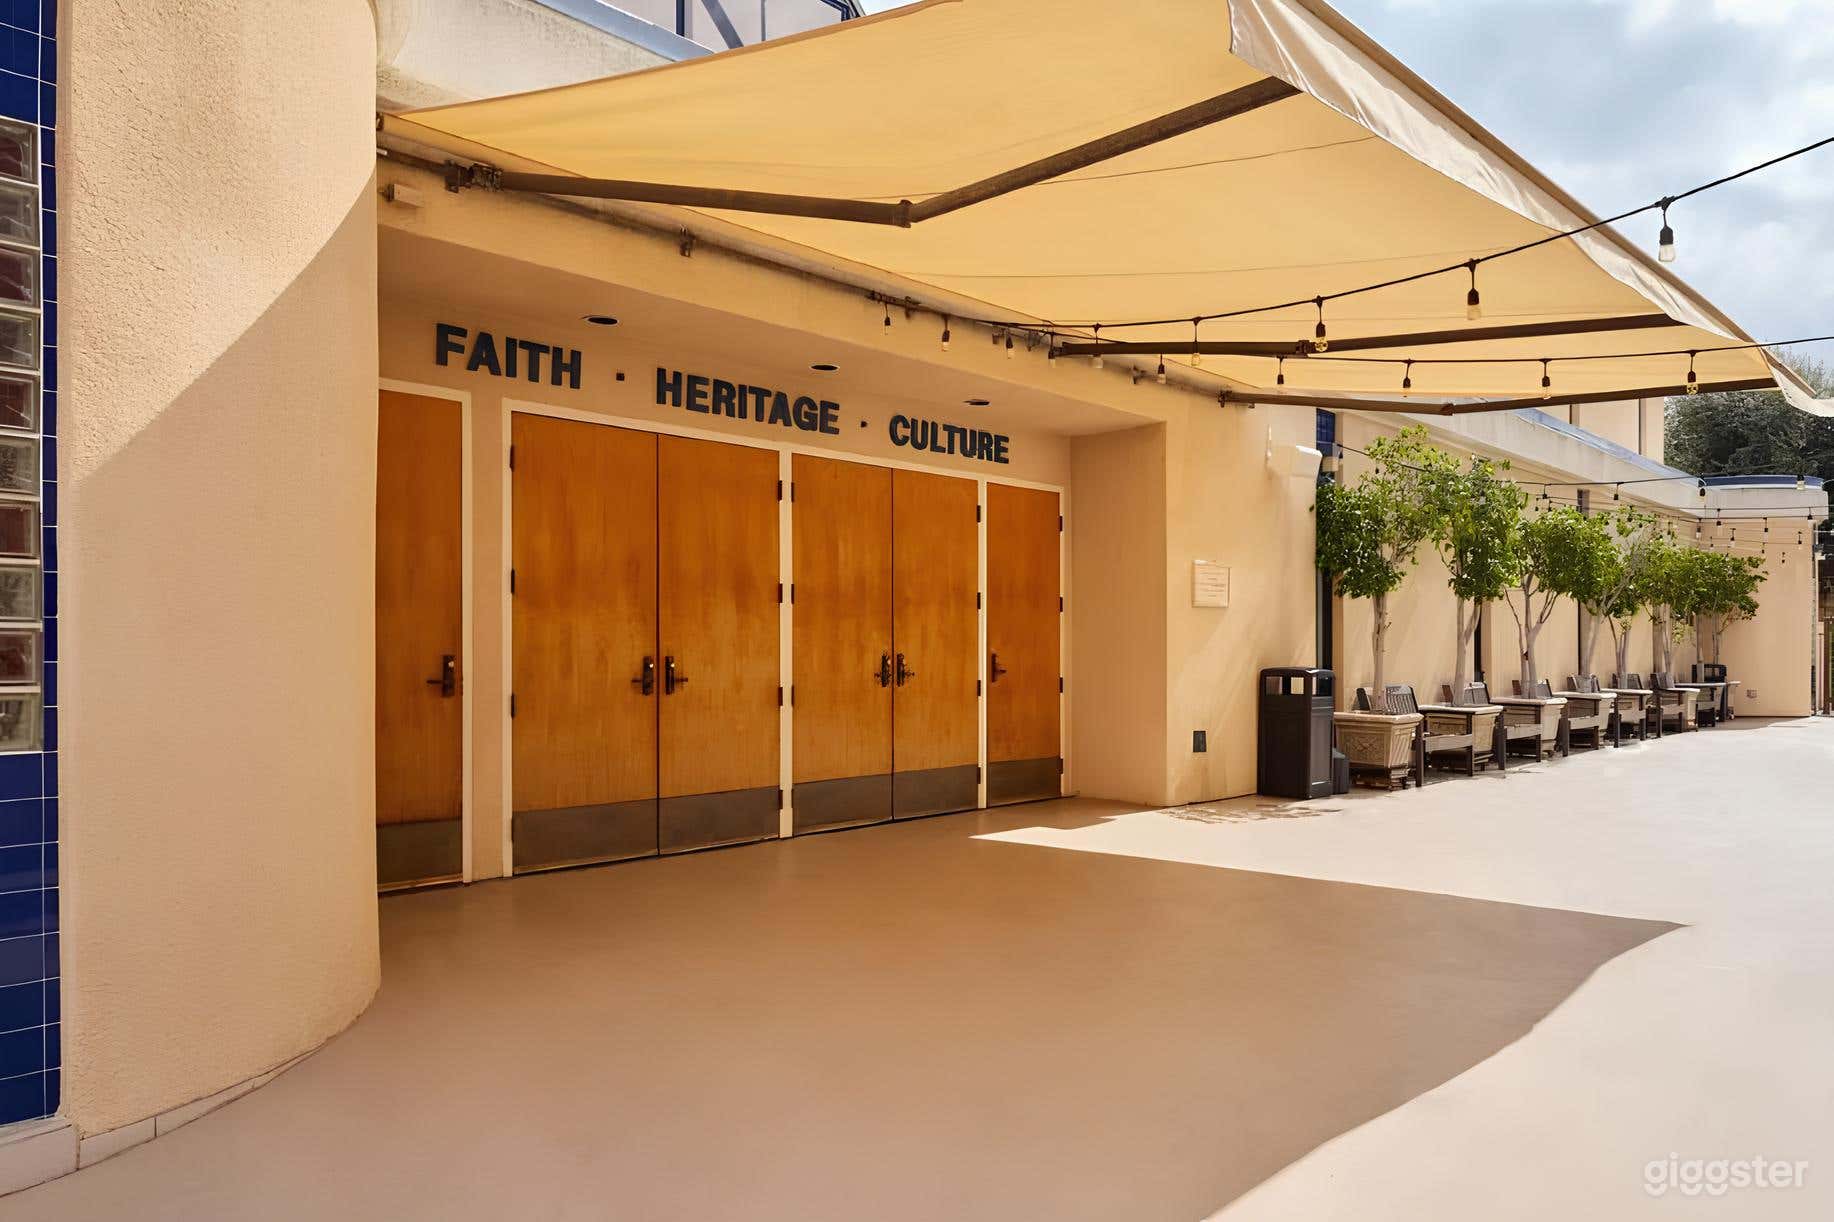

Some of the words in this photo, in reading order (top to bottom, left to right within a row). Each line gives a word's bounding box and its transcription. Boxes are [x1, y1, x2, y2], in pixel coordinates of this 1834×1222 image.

[435, 322, 582, 390] FAITH
[656, 367, 840, 435] HERITAGE
[888, 414, 1010, 464] CULTURE
